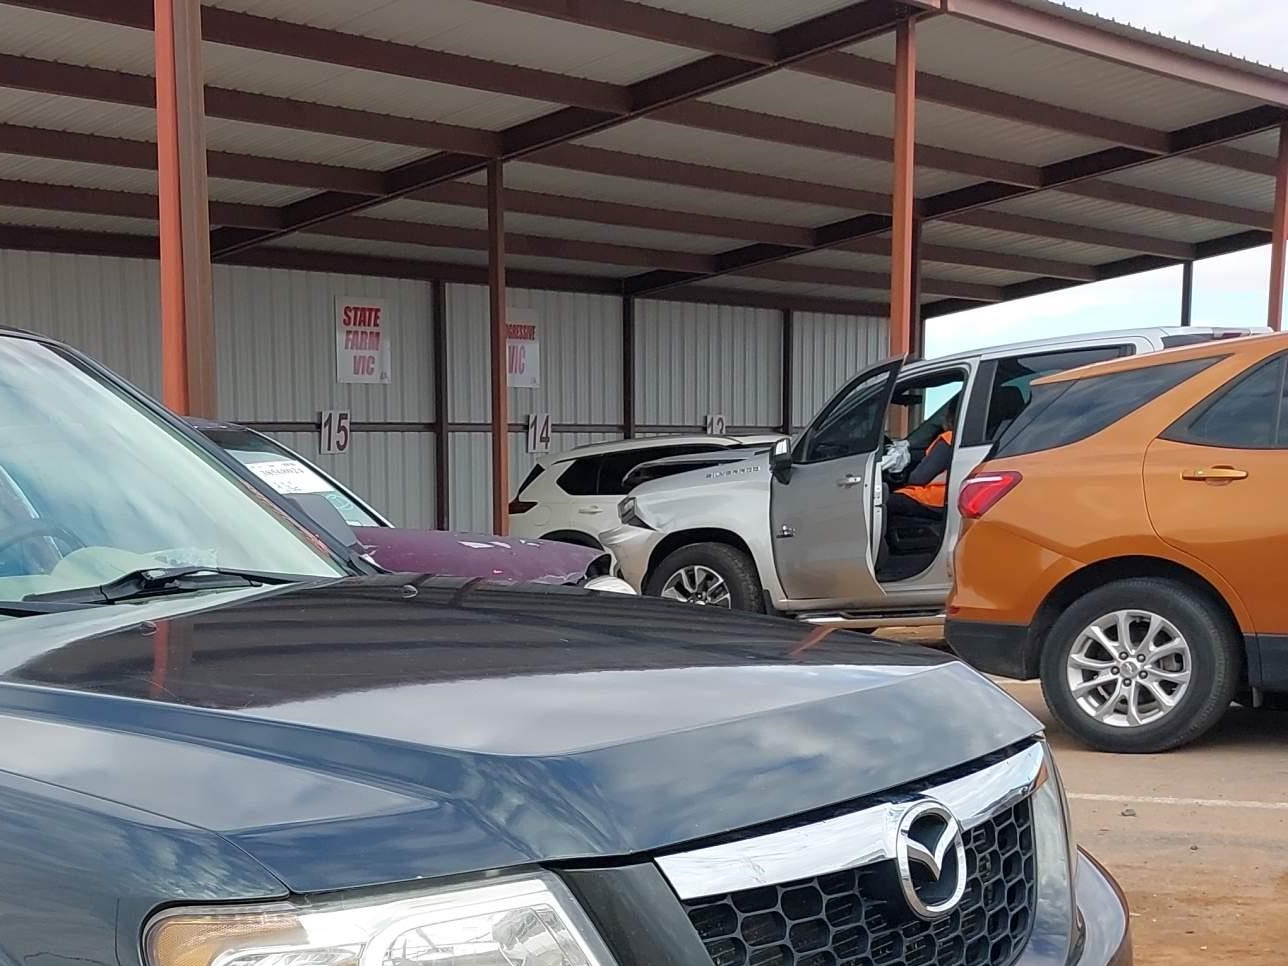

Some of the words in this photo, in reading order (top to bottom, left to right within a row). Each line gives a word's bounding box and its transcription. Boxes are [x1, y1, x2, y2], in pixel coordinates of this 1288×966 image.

[343, 306, 382, 328] STATE
[345, 330, 381, 351] FARM
[353, 355, 376, 376] VIC
[508, 344, 527, 375] VIC
[323, 412, 349, 452] 15
[530, 415, 551, 451] 14
